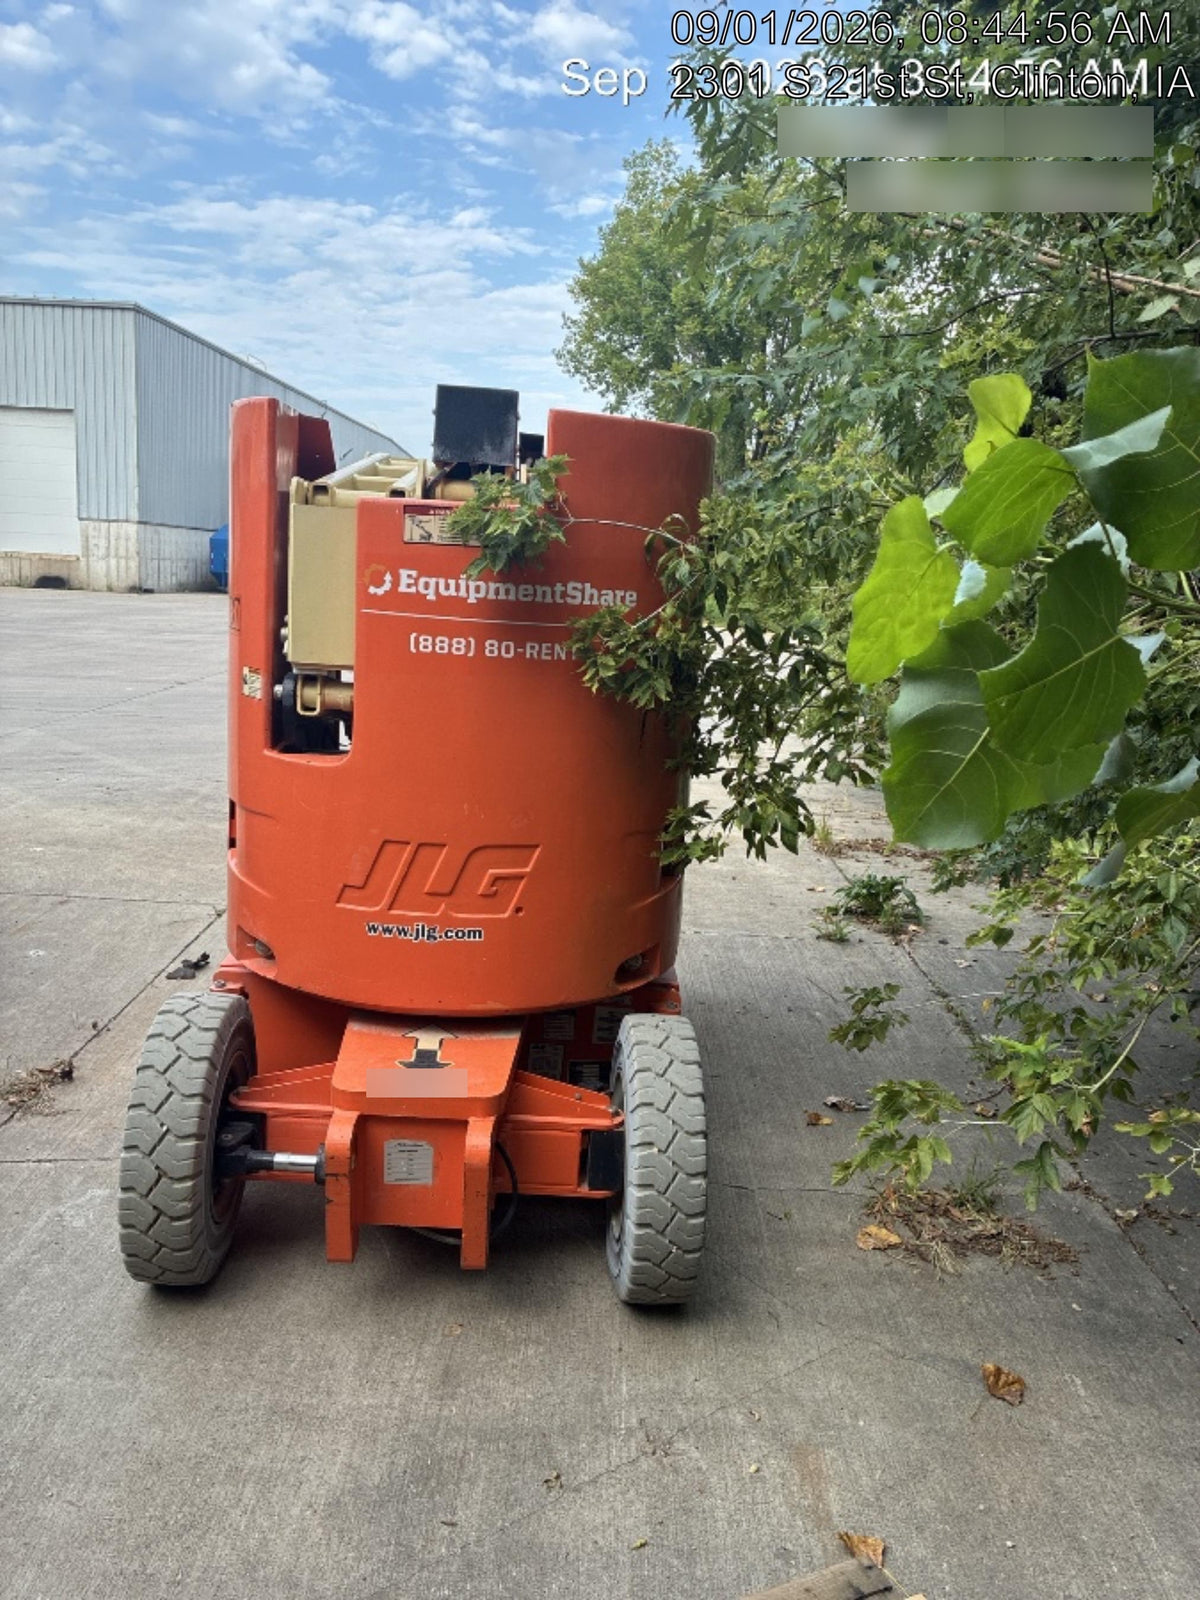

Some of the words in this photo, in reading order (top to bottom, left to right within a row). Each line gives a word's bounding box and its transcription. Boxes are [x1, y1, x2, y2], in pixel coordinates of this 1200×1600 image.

[398, 568, 638, 608] EquipmentShare
[409, 632, 476, 657] (888)
[335, 839, 543, 918] JLG
[365, 921, 484, 943] www.jlg.com
